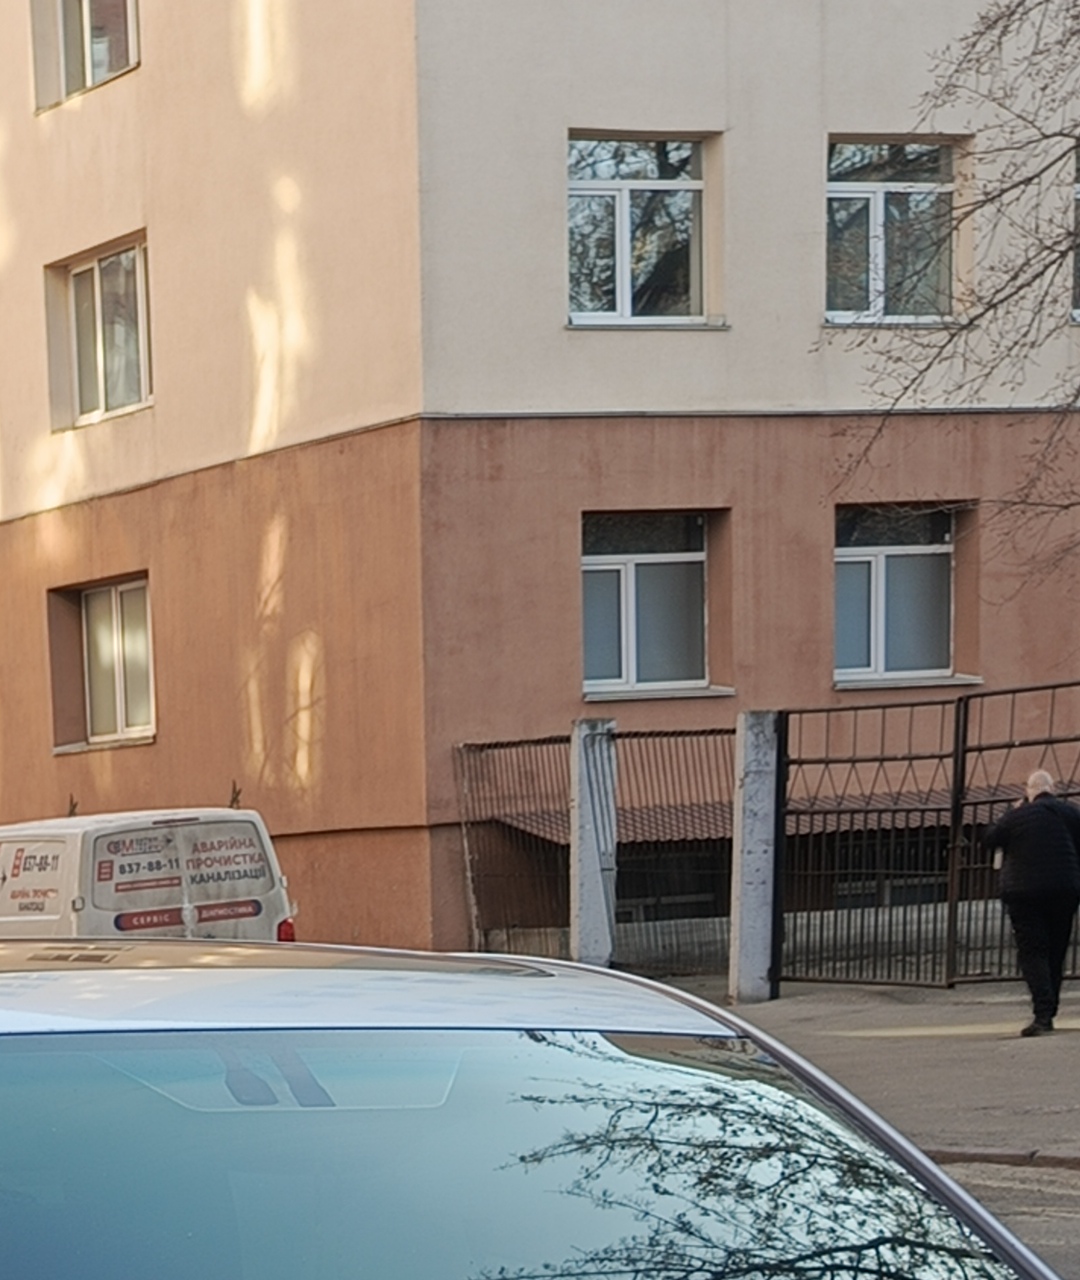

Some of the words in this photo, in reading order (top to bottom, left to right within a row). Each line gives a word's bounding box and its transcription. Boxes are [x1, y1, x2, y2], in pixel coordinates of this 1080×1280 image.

[191, 836, 256, 855] АВАРІЙНА
[119, 857, 180, 875] 837-88-11
[186, 852, 265, 870] ПРОЧИСТКА
[189, 865, 266, 885] КАНАЛІЗАЦІЇ
[132, 914, 171, 926] СЕРВІС
